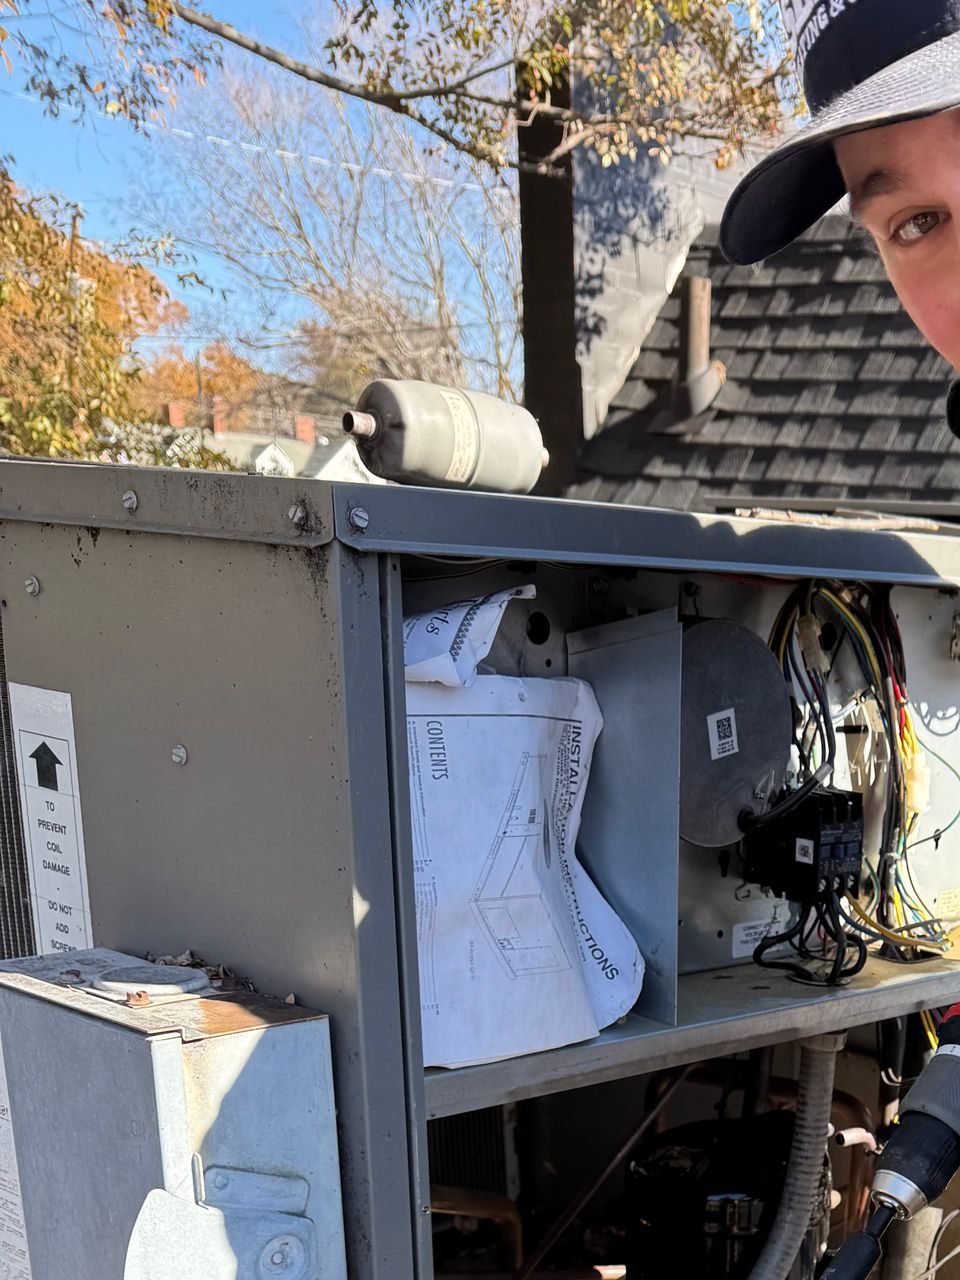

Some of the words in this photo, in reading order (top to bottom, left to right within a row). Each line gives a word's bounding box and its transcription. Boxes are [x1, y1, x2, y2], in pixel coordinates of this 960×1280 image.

[426, 720, 449, 780] CONTENTS
[45, 801, 55, 812] TO
[38, 818, 67, 836] PREVENT
[46, 841, 62, 854] COIL
[42, 860, 70, 876] DAMAGE
[48, 900, 58, 911] DO
[59, 903, 72, 916] NOT
[55, 923, 69, 934] ADD
